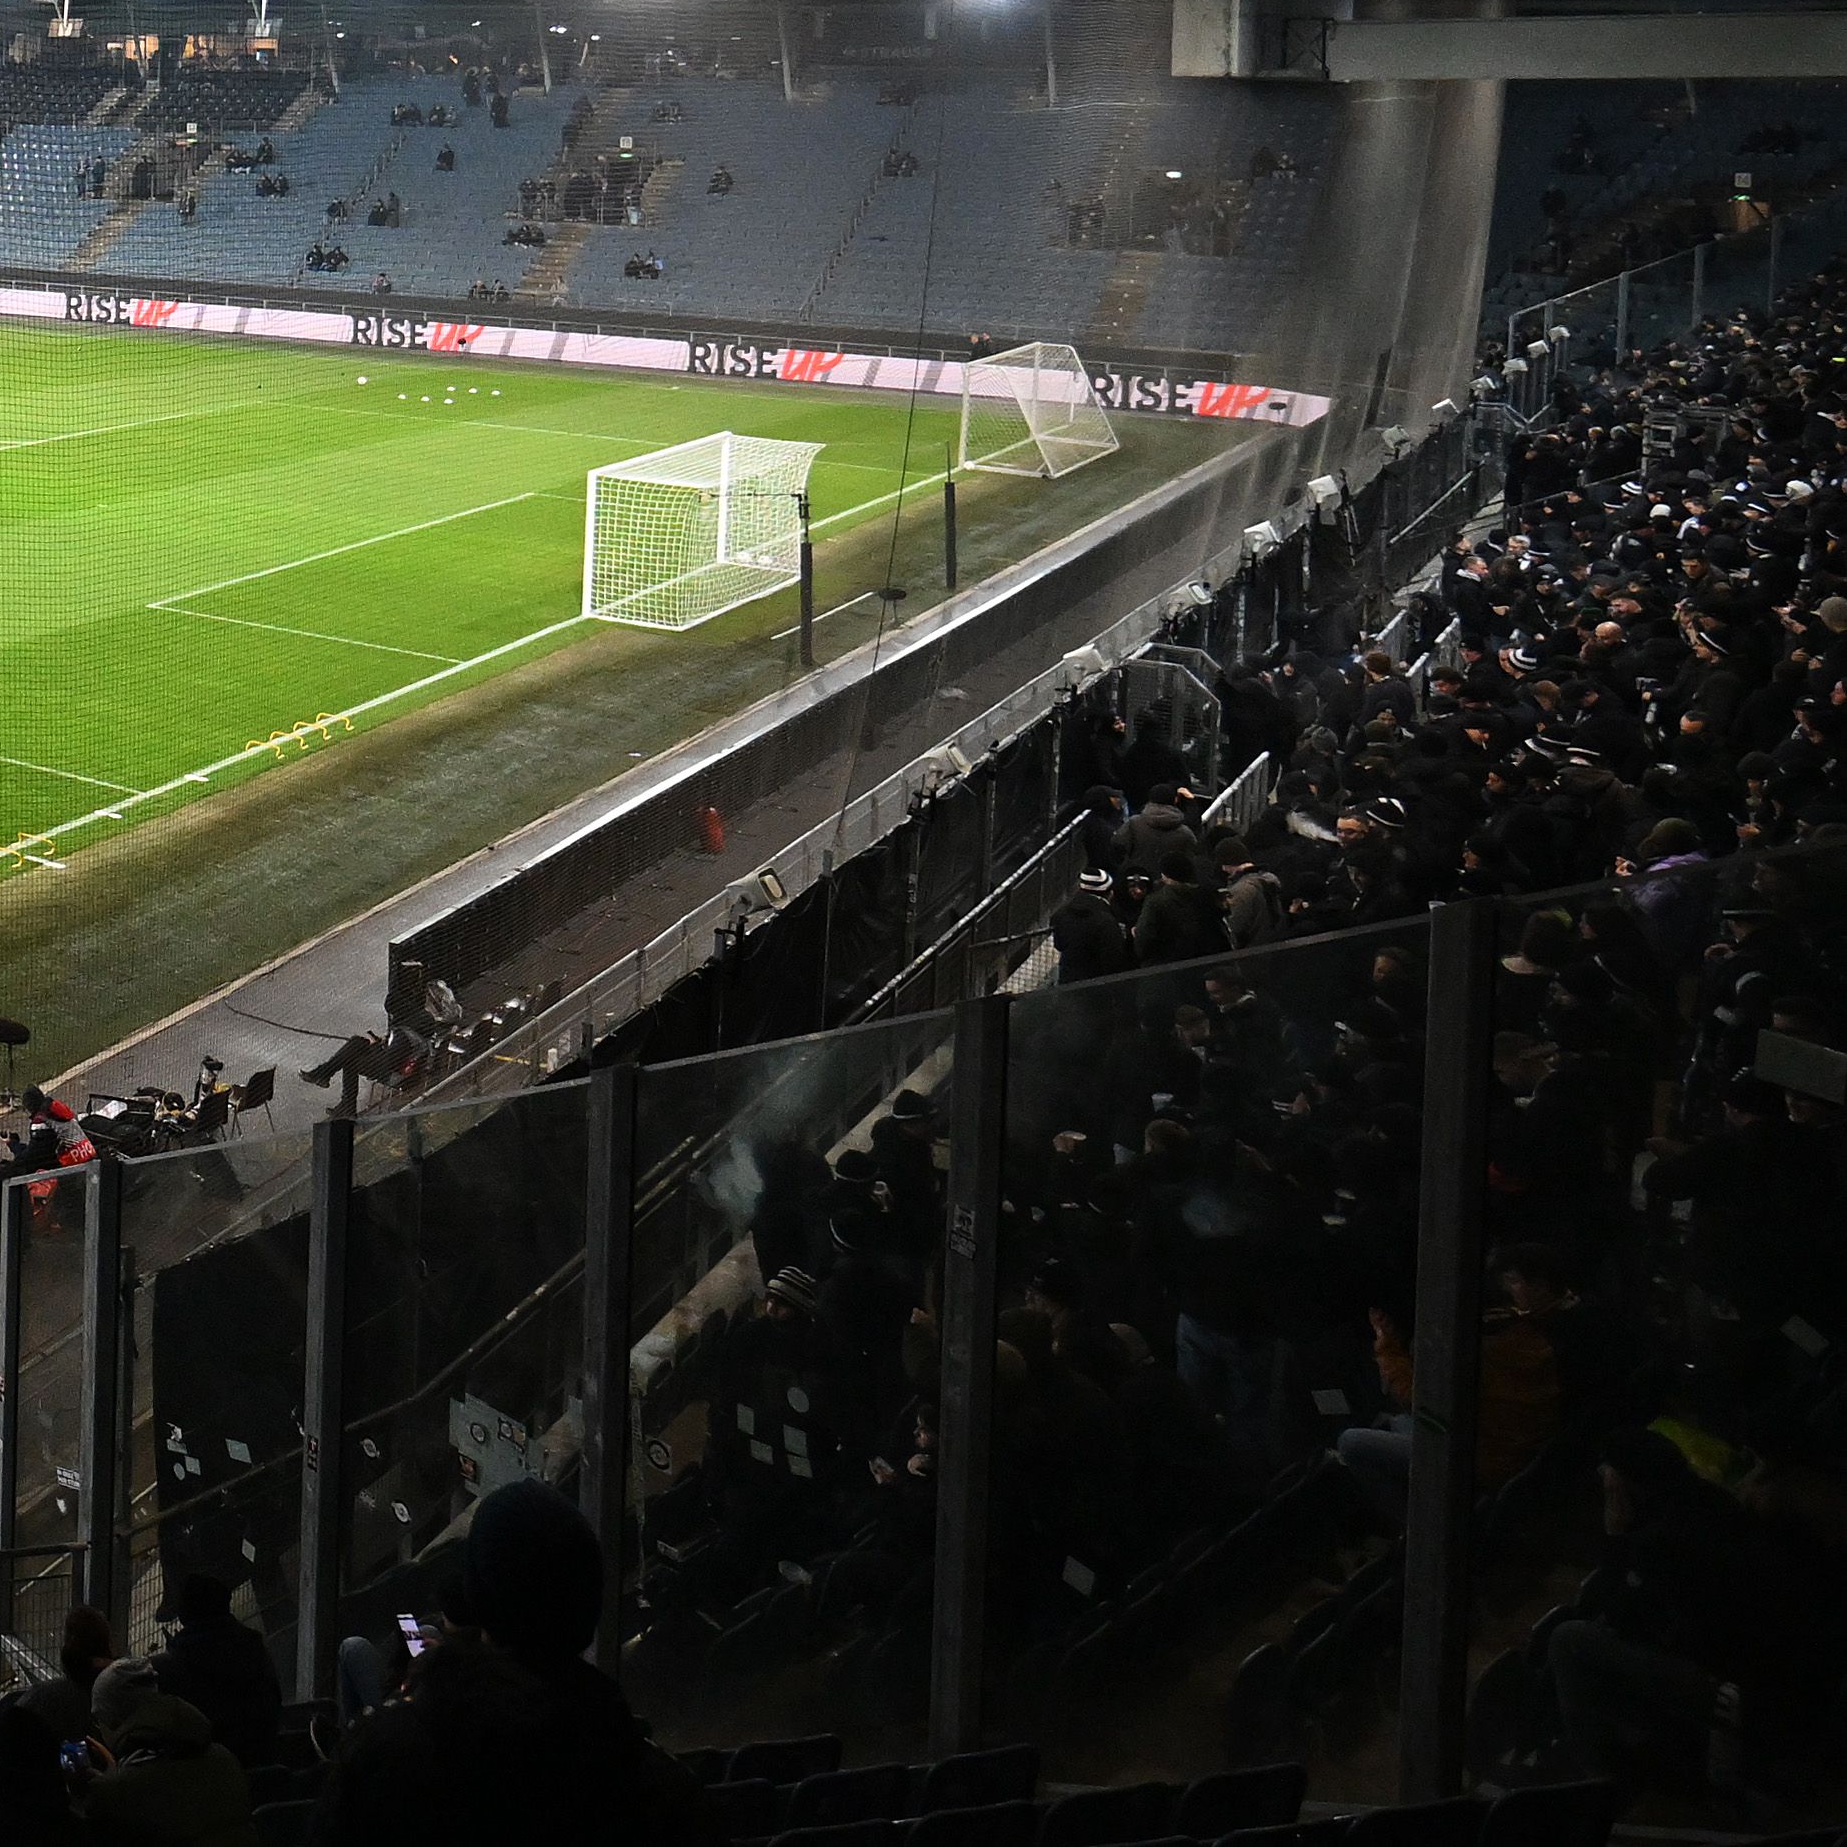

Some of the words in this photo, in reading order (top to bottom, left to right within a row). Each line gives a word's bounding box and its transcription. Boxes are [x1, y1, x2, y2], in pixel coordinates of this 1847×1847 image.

[65, 291, 130, 325] RISE
[132, 299, 178, 327] UP
[352, 316, 428, 350] RISE
[430, 322, 484, 352] UP
[689, 341, 778, 379] RISE
[781, 349, 844, 382] UP
[1086, 371, 1194, 415] RISE
[1198, 382, 1271, 418] UP
